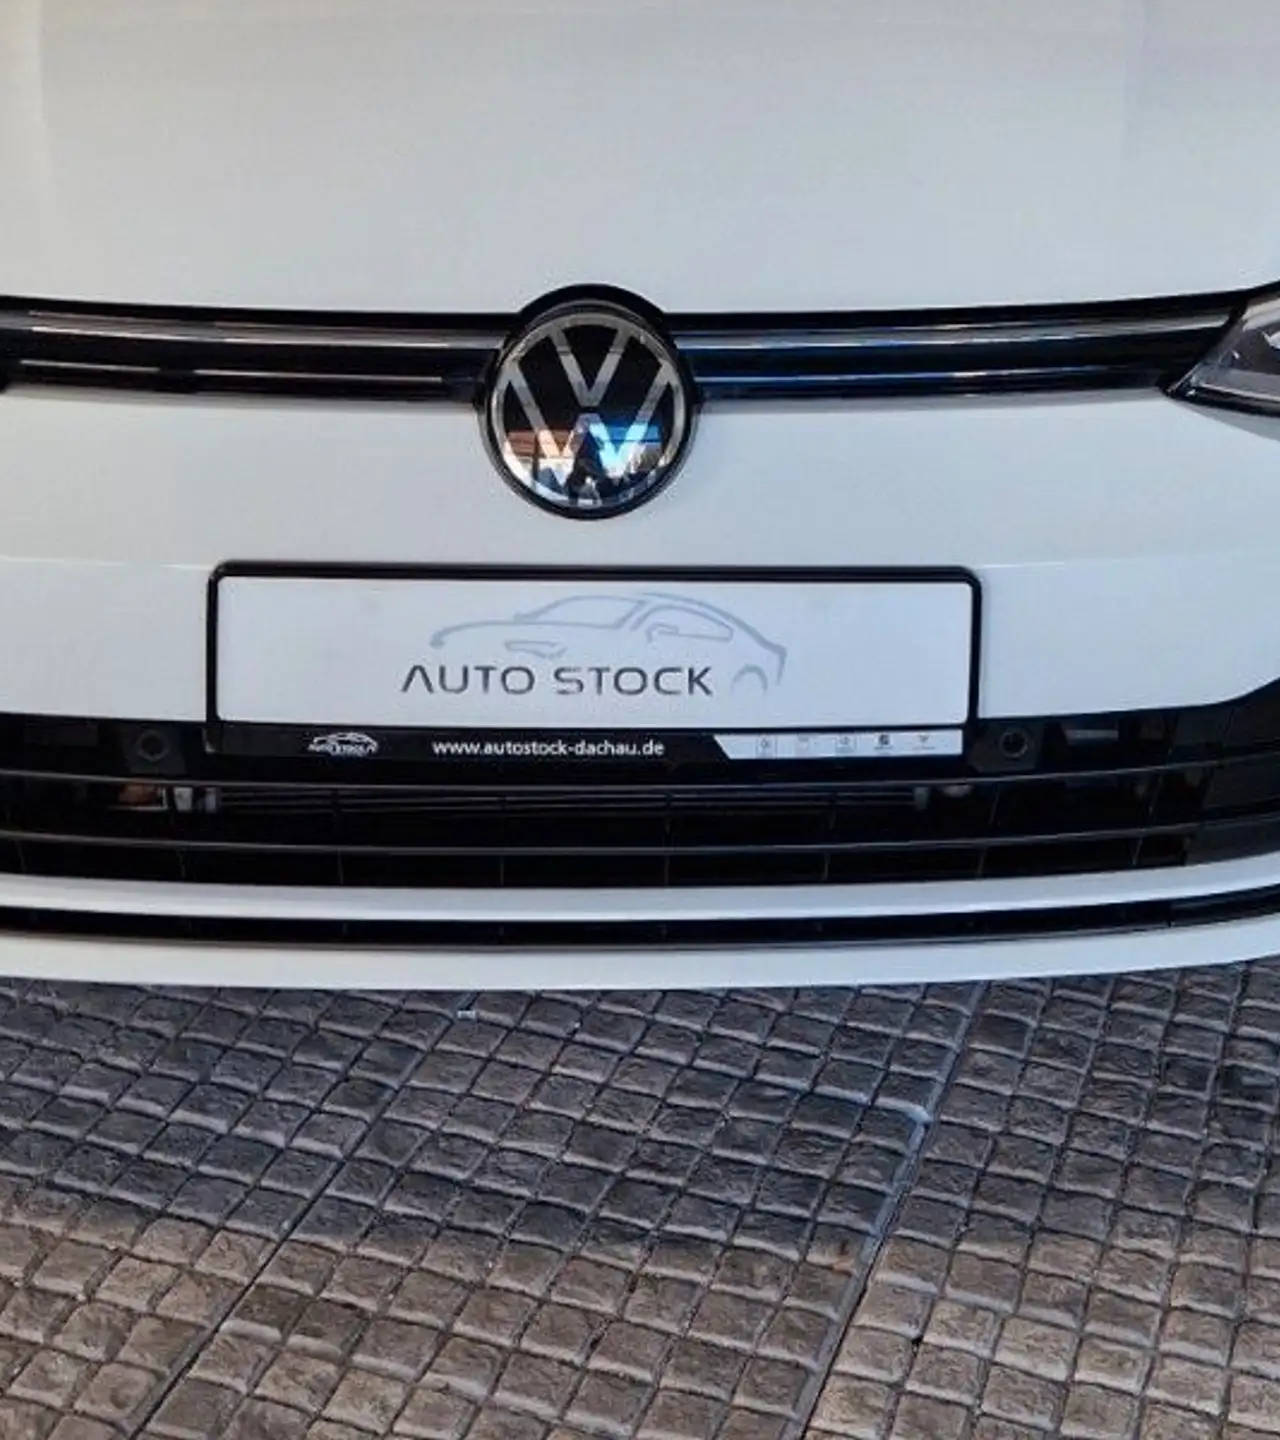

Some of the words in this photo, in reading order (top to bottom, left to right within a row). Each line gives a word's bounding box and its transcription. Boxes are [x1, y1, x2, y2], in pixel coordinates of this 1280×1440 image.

[401, 663, 535, 697] AUTO
[553, 663, 714, 697] STOCK
[431, 735, 666, 758] www.autostock-dachau.de
